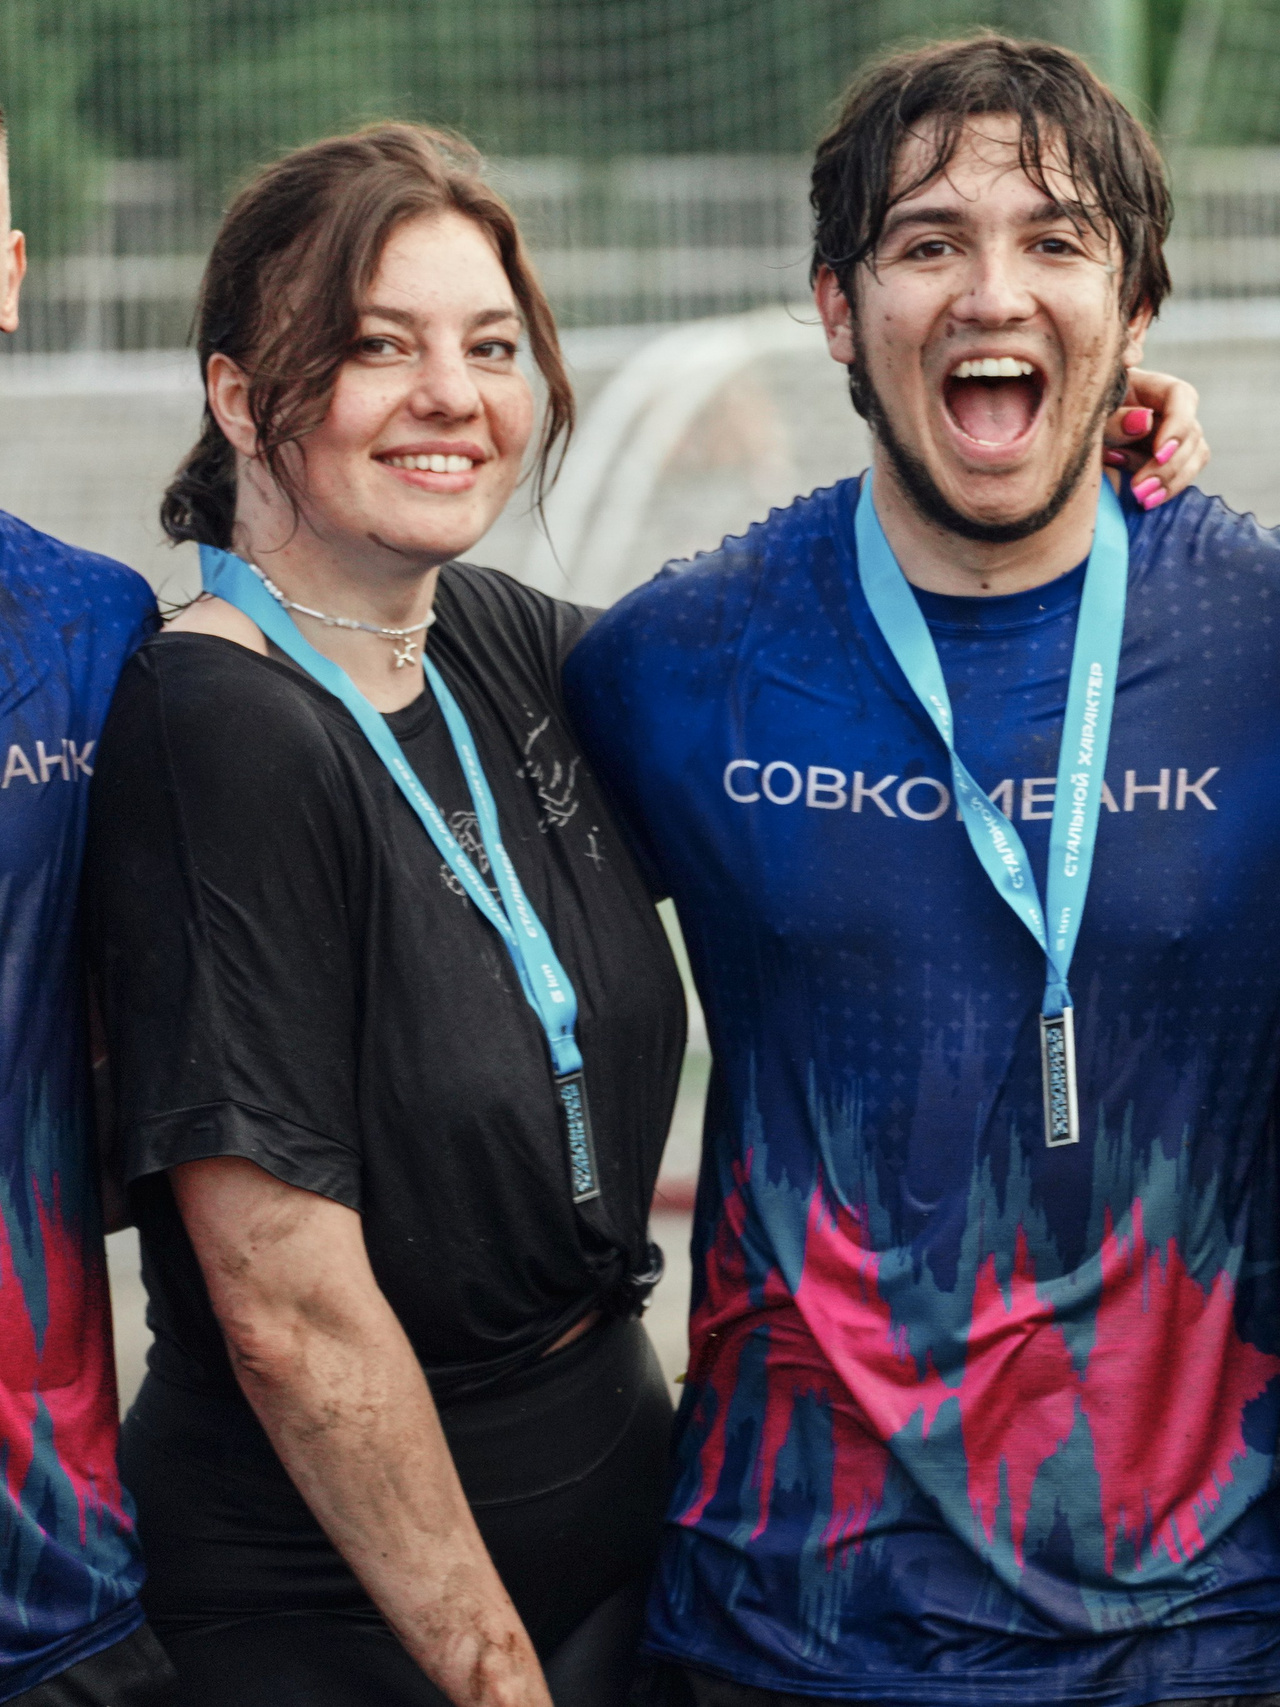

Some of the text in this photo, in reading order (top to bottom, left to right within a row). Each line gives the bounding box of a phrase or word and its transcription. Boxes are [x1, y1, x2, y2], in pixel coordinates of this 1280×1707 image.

[970, 797, 1024, 889] СТАЛЬНОЙ
[1064, 662, 1104, 877] СТАЛЬНОЙ ХАРАКТЕР
